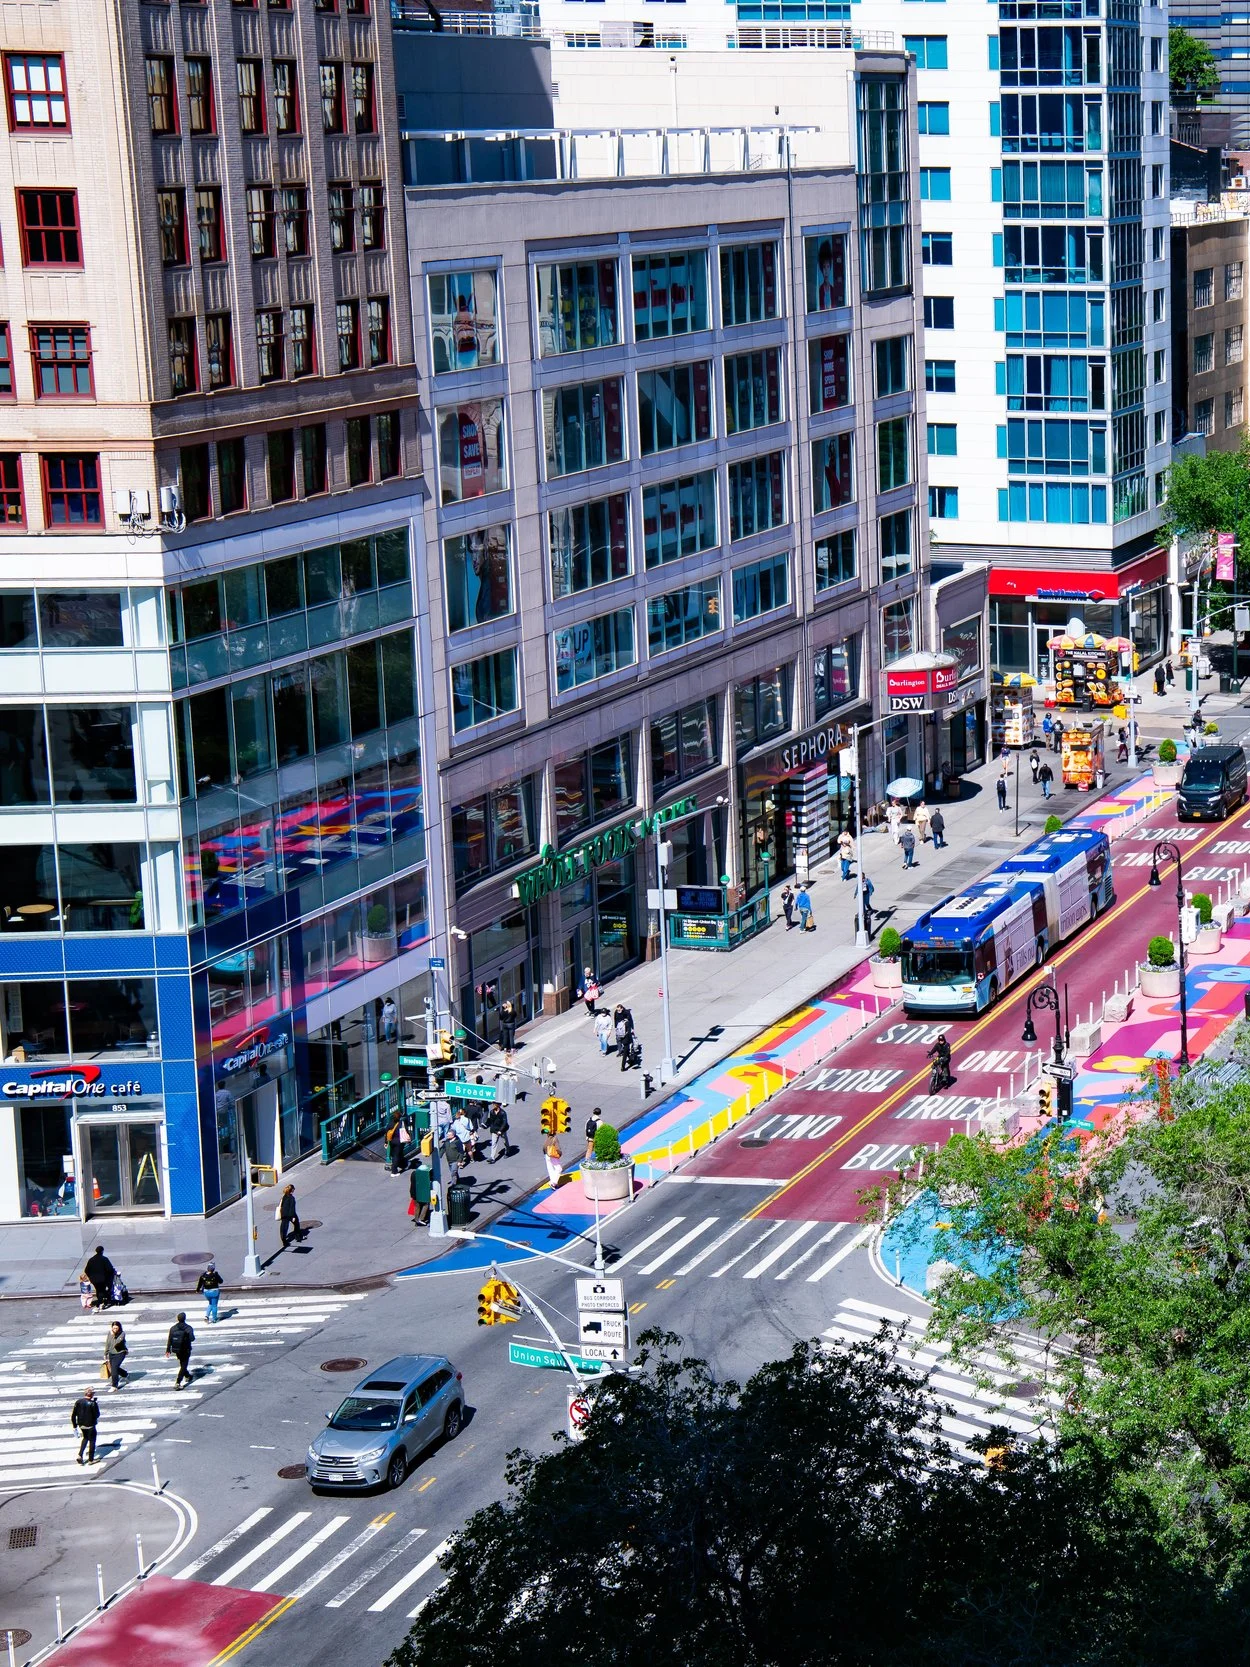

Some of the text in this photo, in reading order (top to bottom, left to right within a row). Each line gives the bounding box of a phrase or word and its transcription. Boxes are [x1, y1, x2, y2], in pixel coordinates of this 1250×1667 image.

[464, 443, 480, 458] SAVE
[889, 679, 925, 688] Burlington
[891, 696, 924, 710] DSW
[948, 691, 956, 703] DS
[782, 723, 843, 773] SEPHORA
[1131, 828, 1206, 840] TRUCK
[515, 847, 582, 906] WHOLE
[581, 819, 638, 873] FOODS
[1181, 867, 1241, 881] BUS
[877, 1023, 954, 1045] BUS
[403, 1057, 424, 1066] Broadway
[957, 1050, 1044, 1073] ONLY
[110, 1081, 141, 1092] café
[793, 1069, 904, 1092] TRUCK
[455, 1086, 496, 1098] Broadwa
[738, 1115, 844, 1139] ONLY
[513, 1350, 542, 1363] Union
[581, 1361, 600, 1370] Eas
[585, 1349, 607, 1357] LOCAL
